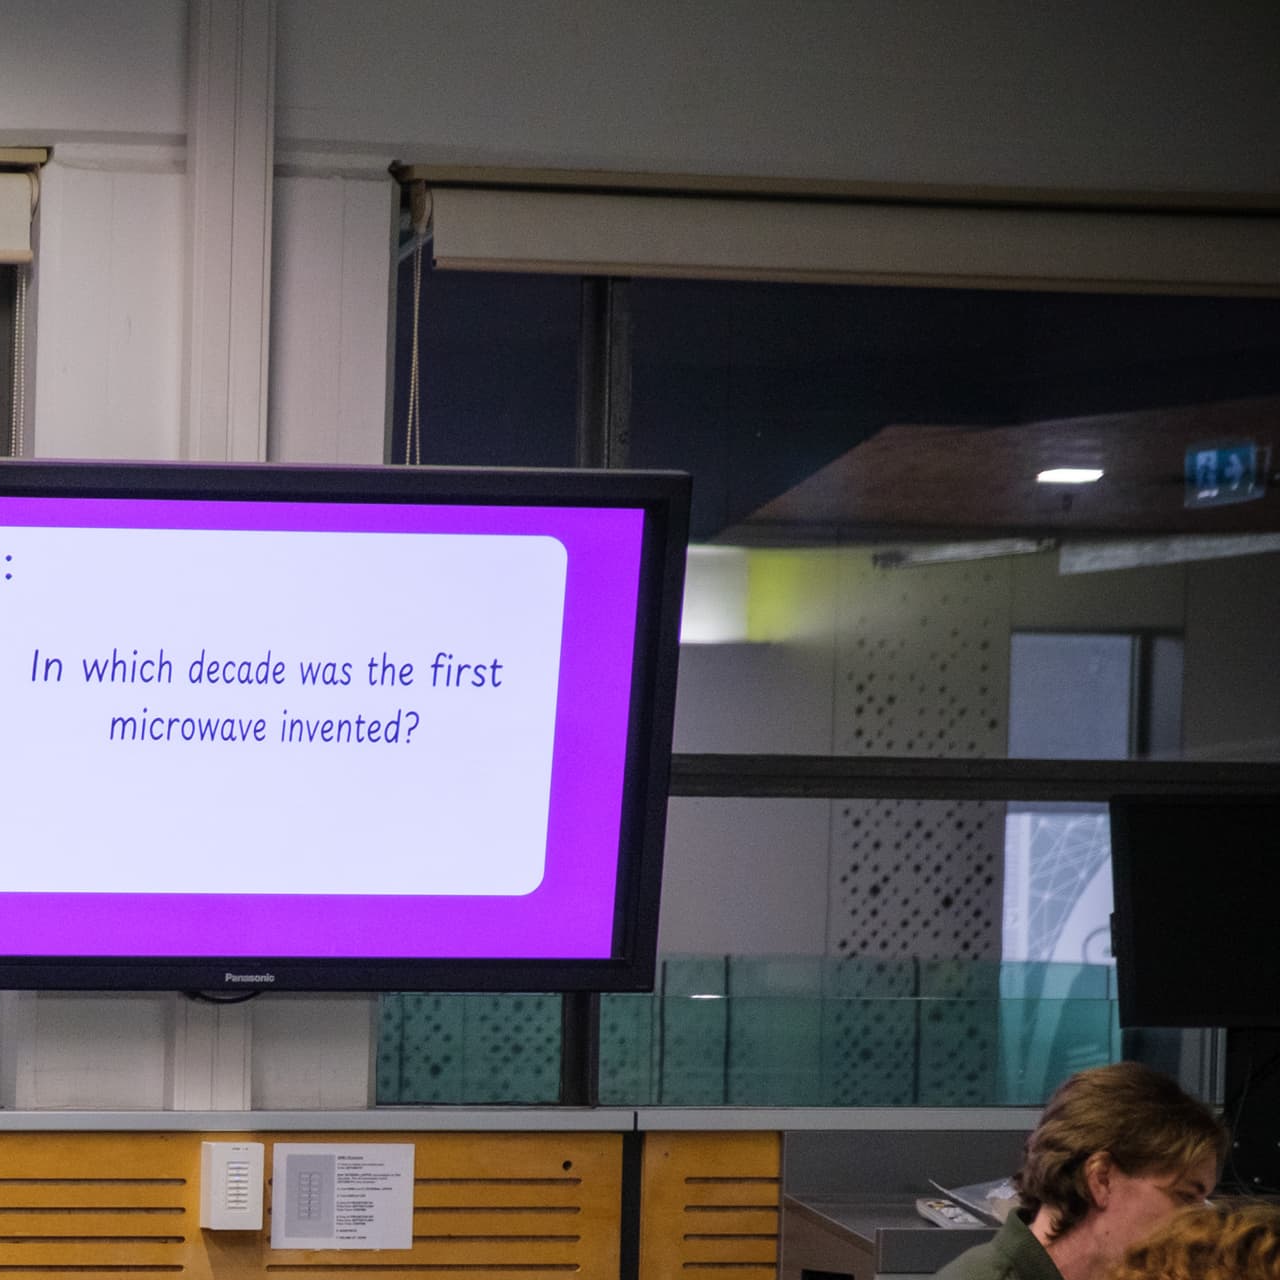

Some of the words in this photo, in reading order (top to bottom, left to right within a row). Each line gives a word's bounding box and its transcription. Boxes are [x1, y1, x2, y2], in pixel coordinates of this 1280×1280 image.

[31, 649, 63, 682] In
[82, 647, 173, 684] which
[188, 648, 286, 685] decade
[299, 662, 353, 686] was
[367, 651, 414, 687] the
[430, 652, 504, 688] first
[109, 707, 266, 742] microwave
[281, 708, 420, 744] invented?
